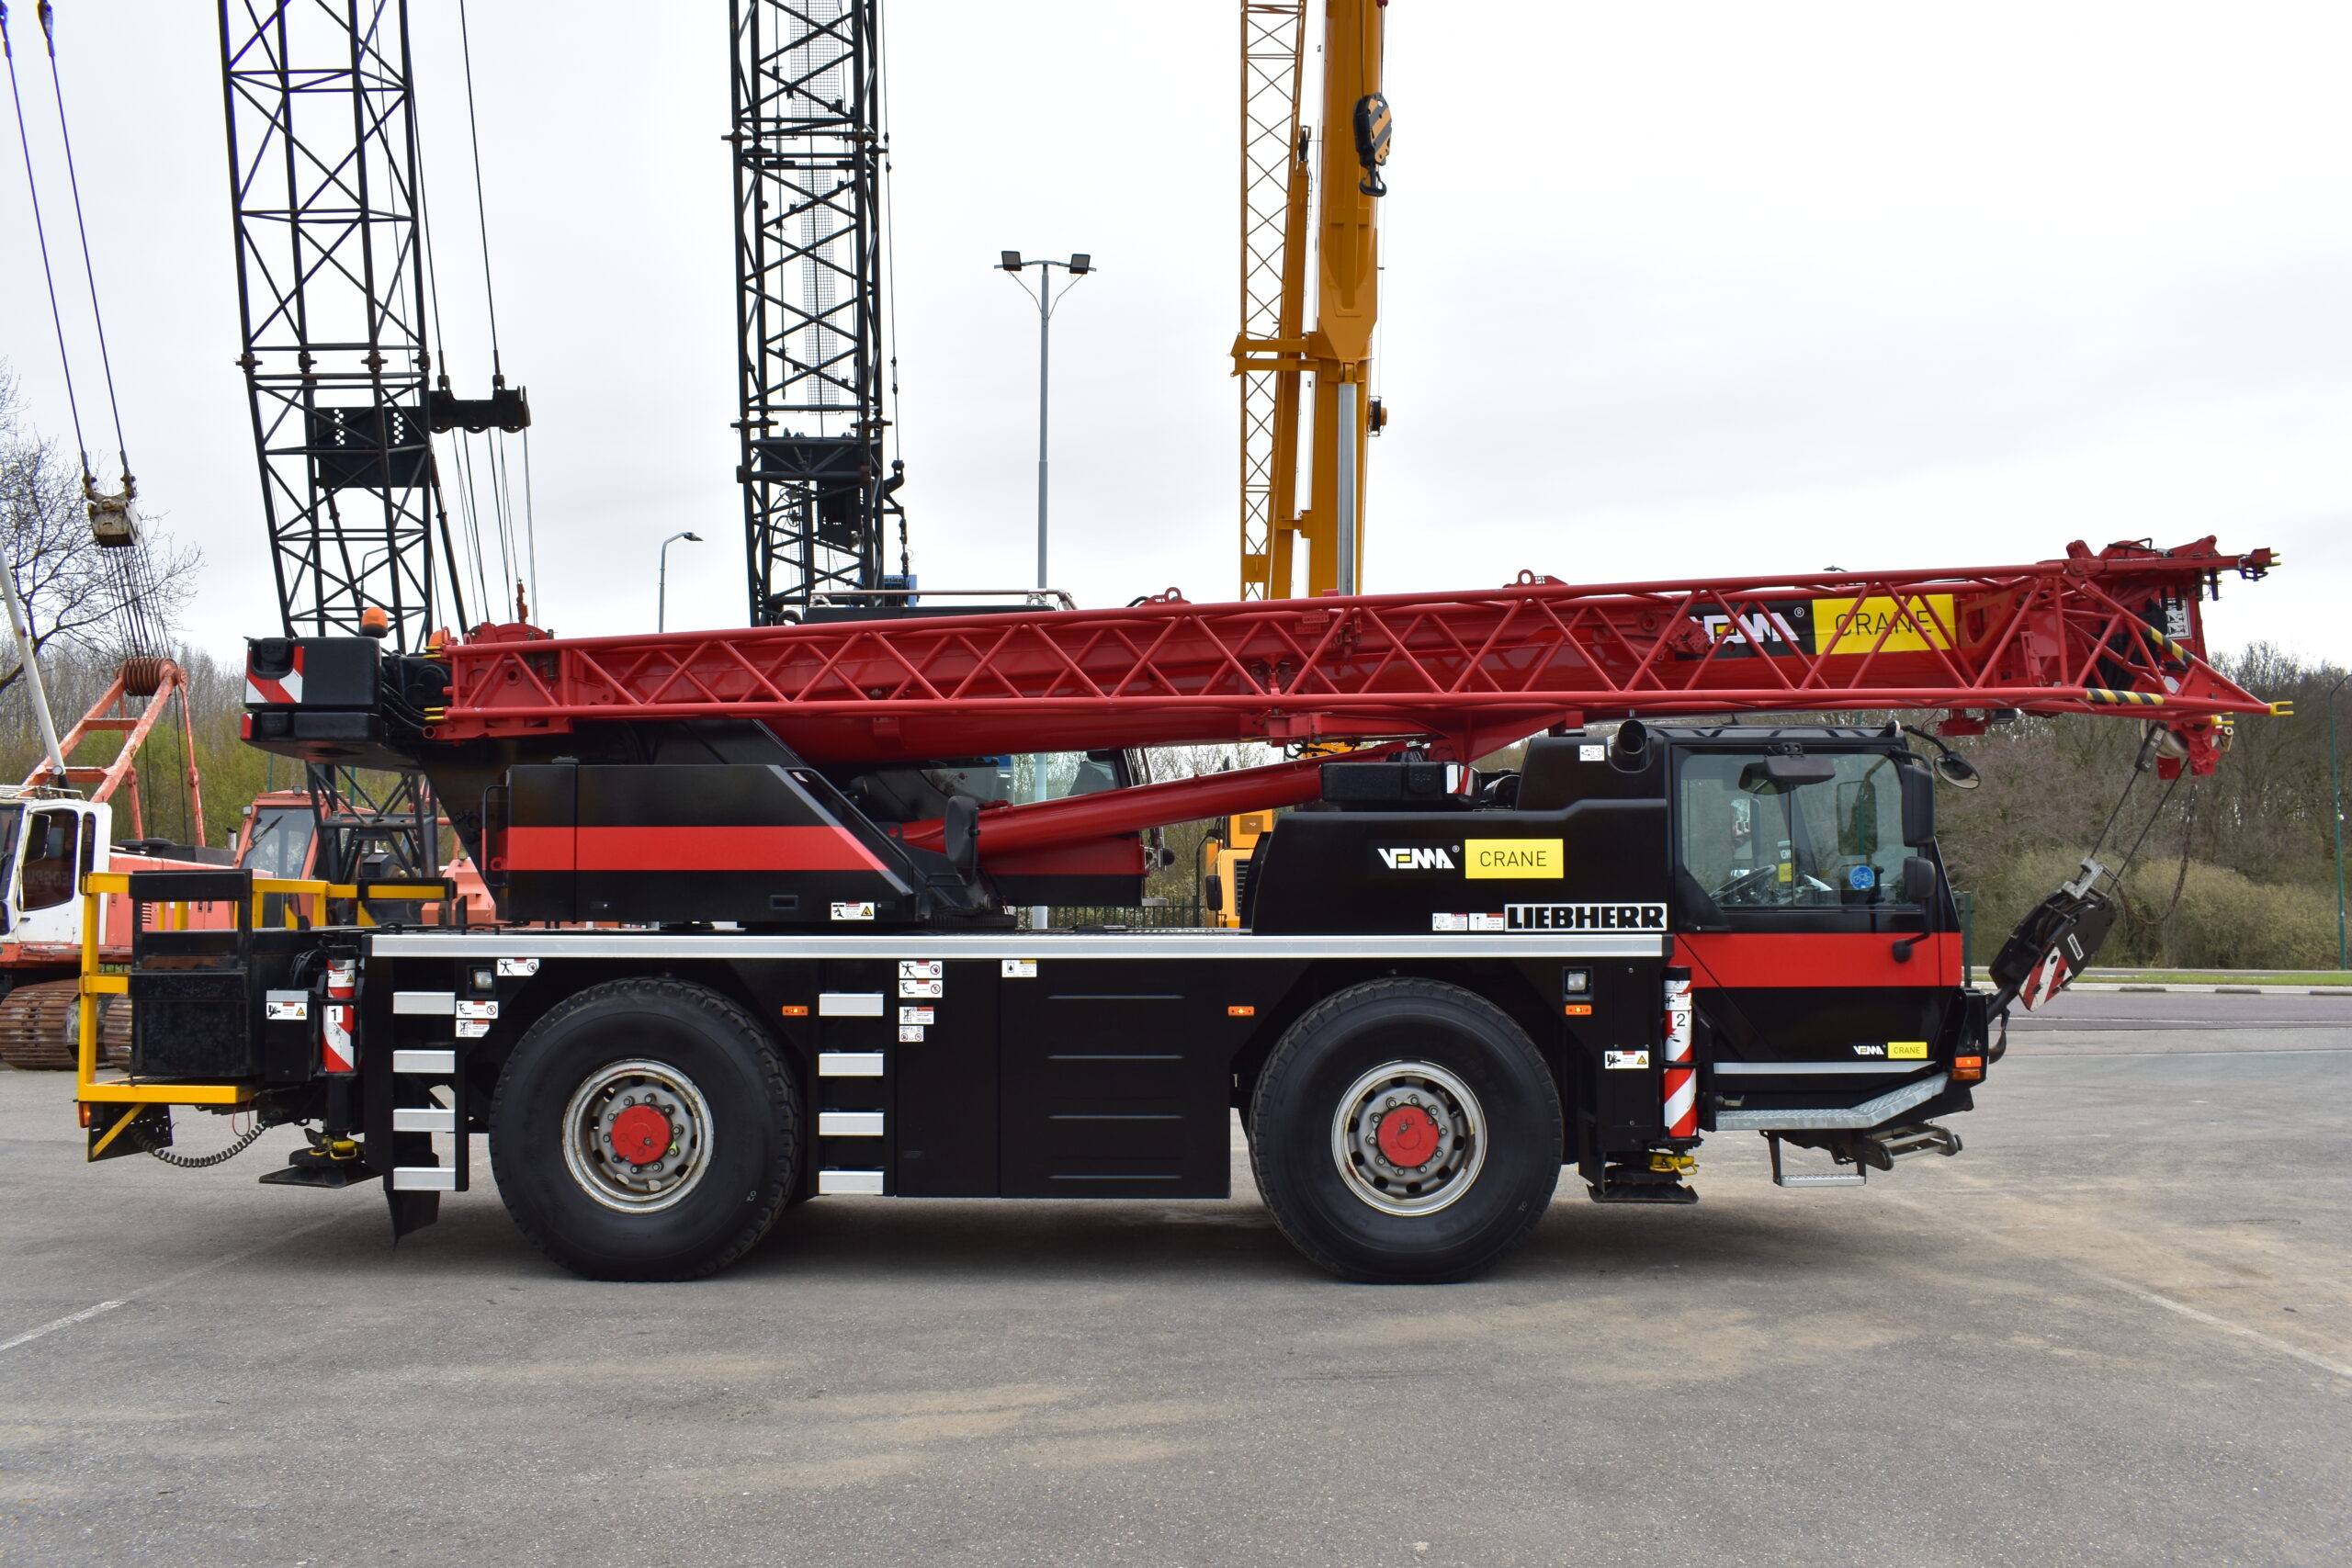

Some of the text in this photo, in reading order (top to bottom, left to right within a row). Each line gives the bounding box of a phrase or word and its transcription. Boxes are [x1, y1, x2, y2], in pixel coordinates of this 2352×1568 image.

[1836, 610, 1931, 636] CRANE
[1479, 851, 1547, 867] CRANE
[1507, 906, 1664, 930] LIEBHERR
[331, 1008, 337, 1021] 1
[1676, 1013, 1686, 1027] 2
[1894, 1046, 1921, 1055] CRANE
